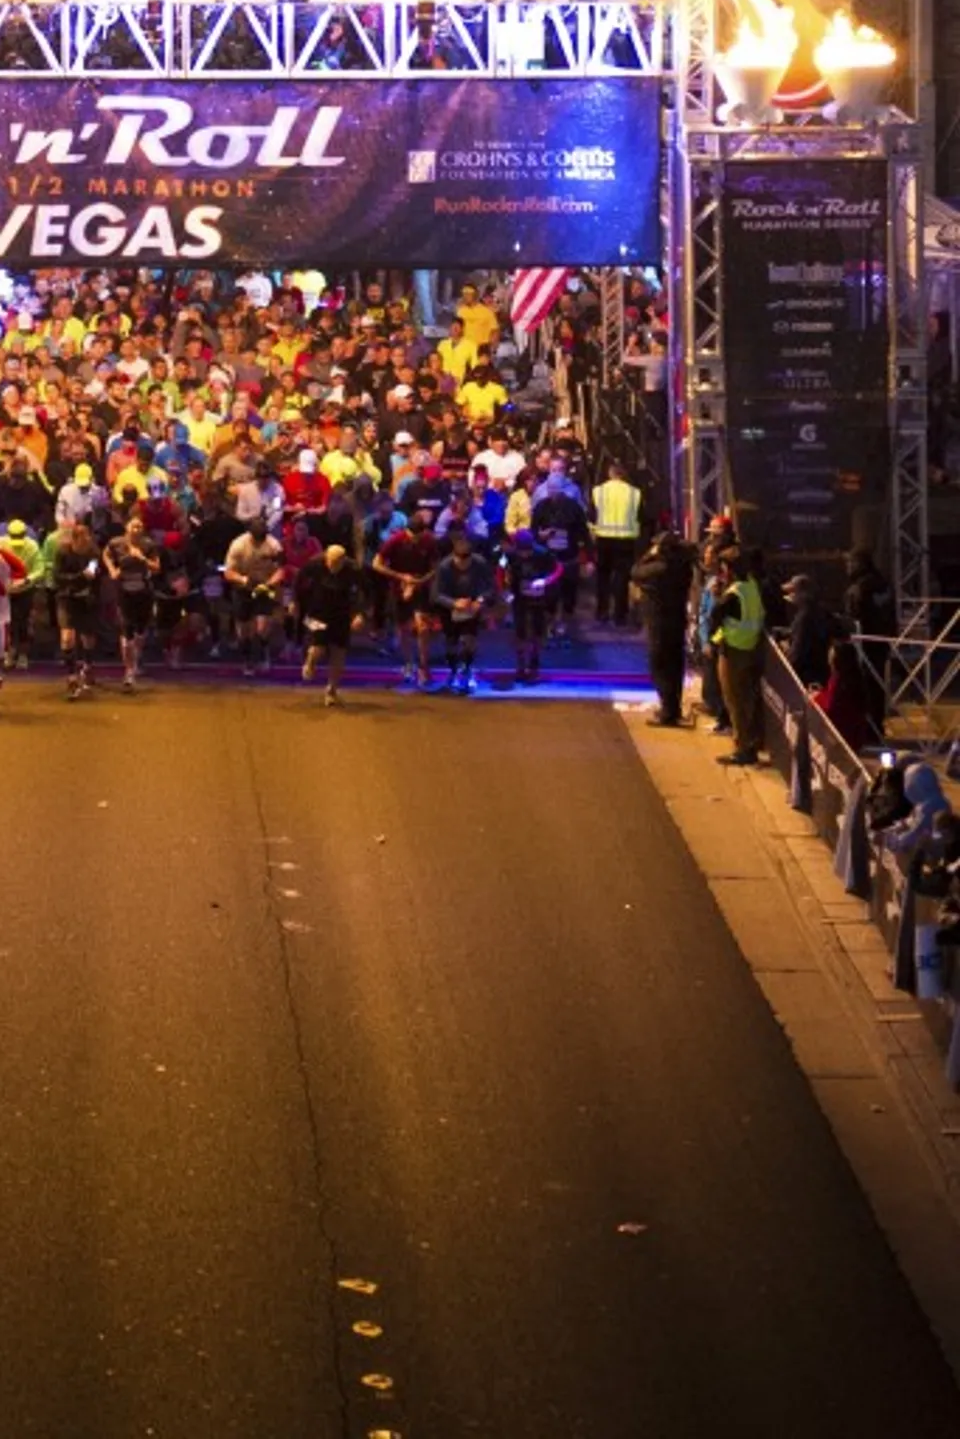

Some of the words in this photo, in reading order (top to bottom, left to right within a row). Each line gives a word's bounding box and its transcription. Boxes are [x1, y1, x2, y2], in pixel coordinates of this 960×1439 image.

[96, 95, 346, 168] Roll
[526, 152, 539, 167] &
[441, 169, 529, 180] FOUNDATION
[535, 169, 550, 180] OF
[7, 176, 63, 196] 1/2
[88, 176, 257, 198] MARATHON
[730, 199, 799, 218] Rock
[822, 198, 881, 216] Roll
[741, 220, 820, 230] MARATHON
